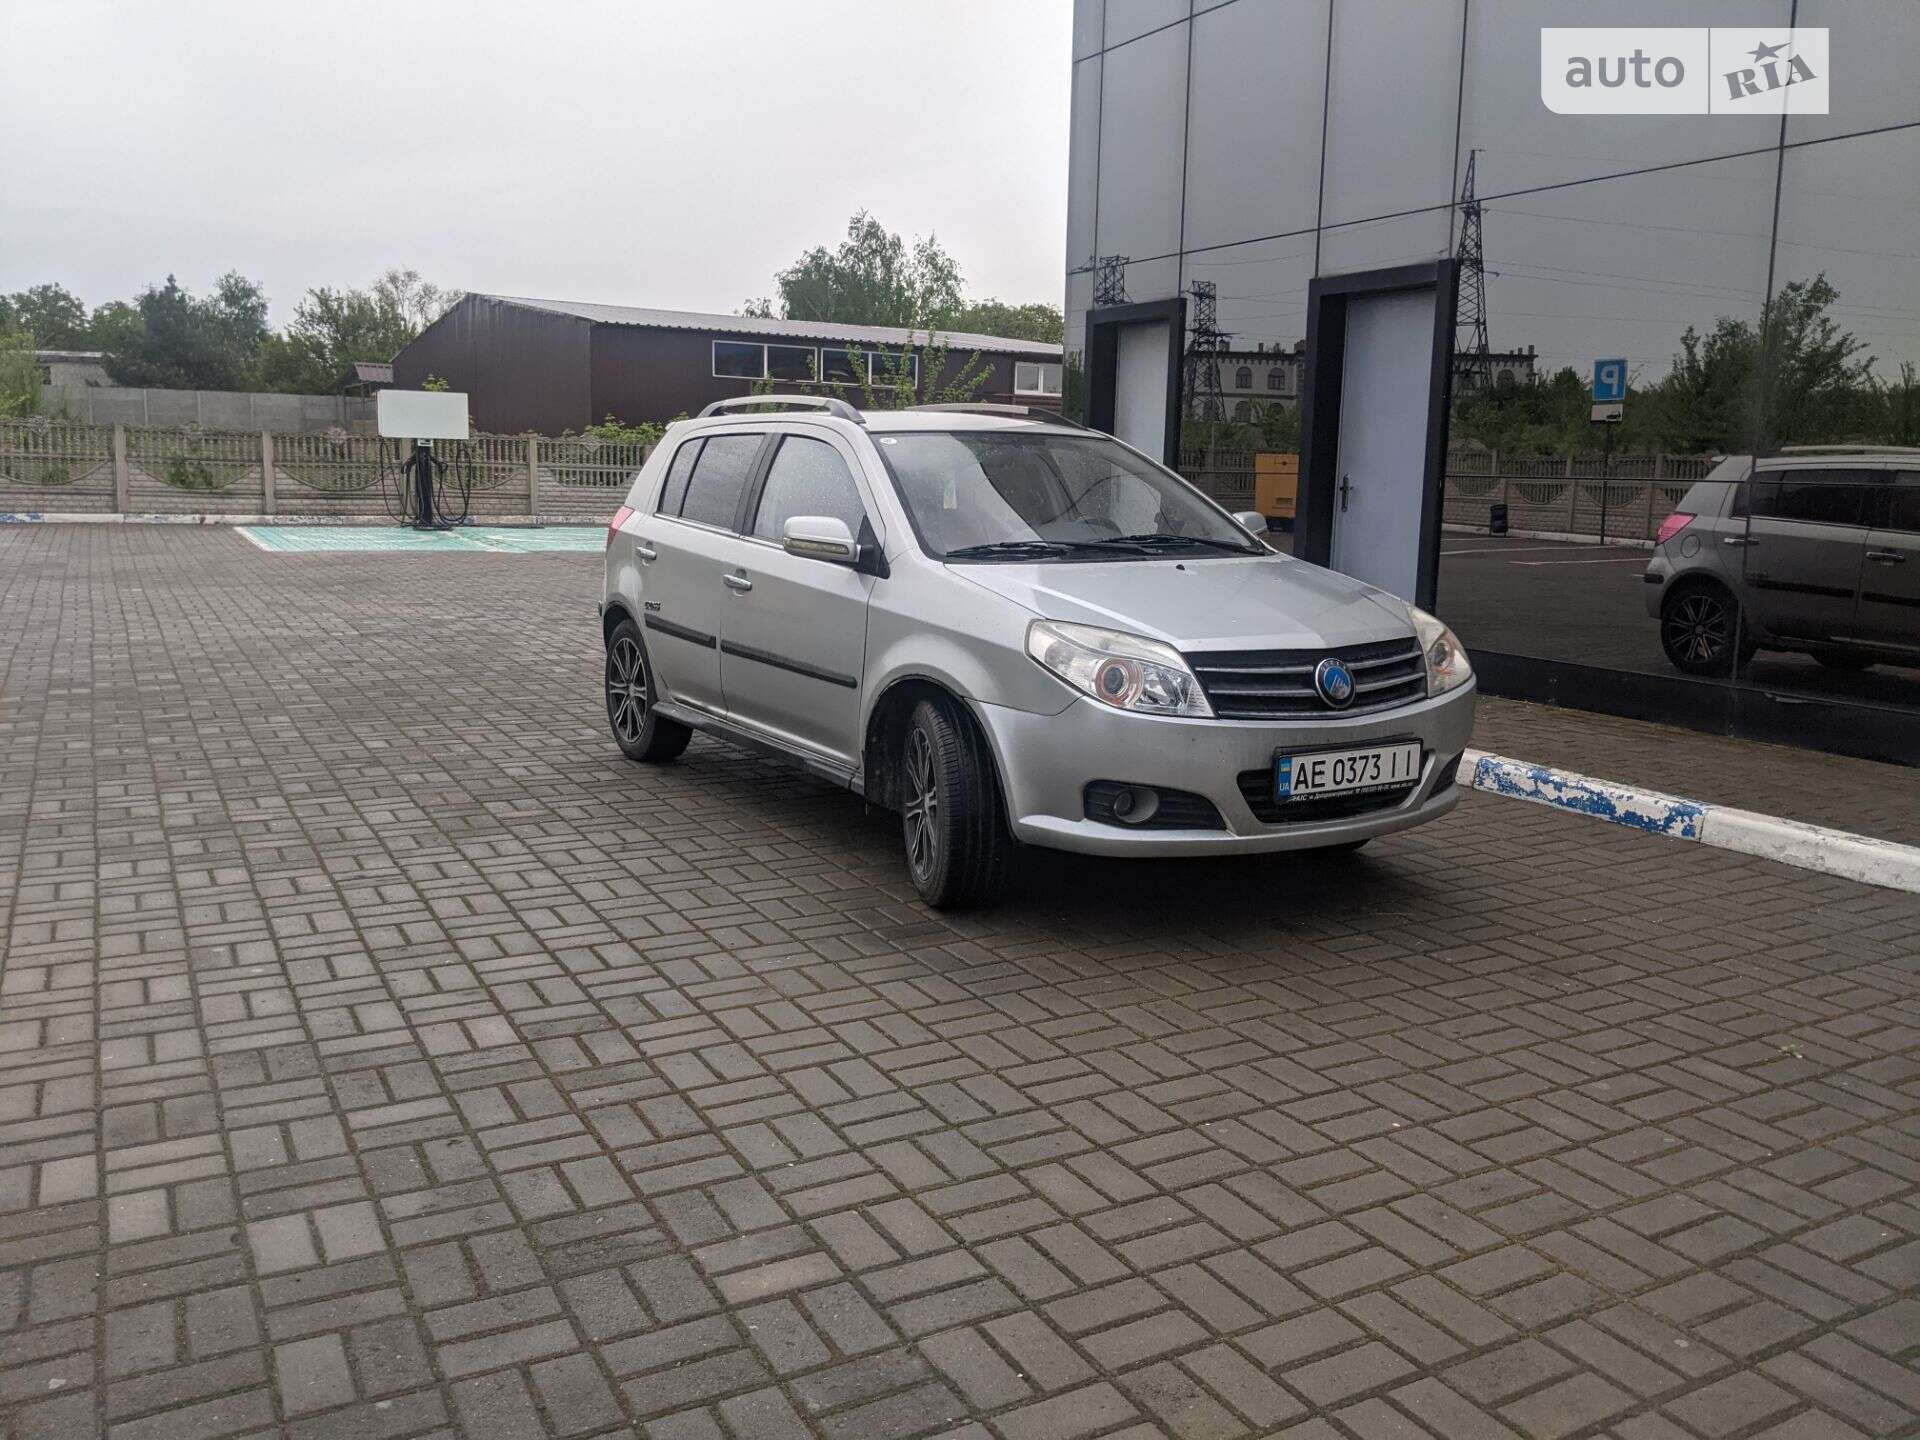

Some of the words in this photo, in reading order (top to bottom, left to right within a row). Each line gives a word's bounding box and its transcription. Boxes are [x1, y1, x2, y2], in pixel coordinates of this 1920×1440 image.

[1294, 761, 1326, 790] AE
[1333, 754, 1381, 786] 0373
[1279, 782, 1290, 792] UA
